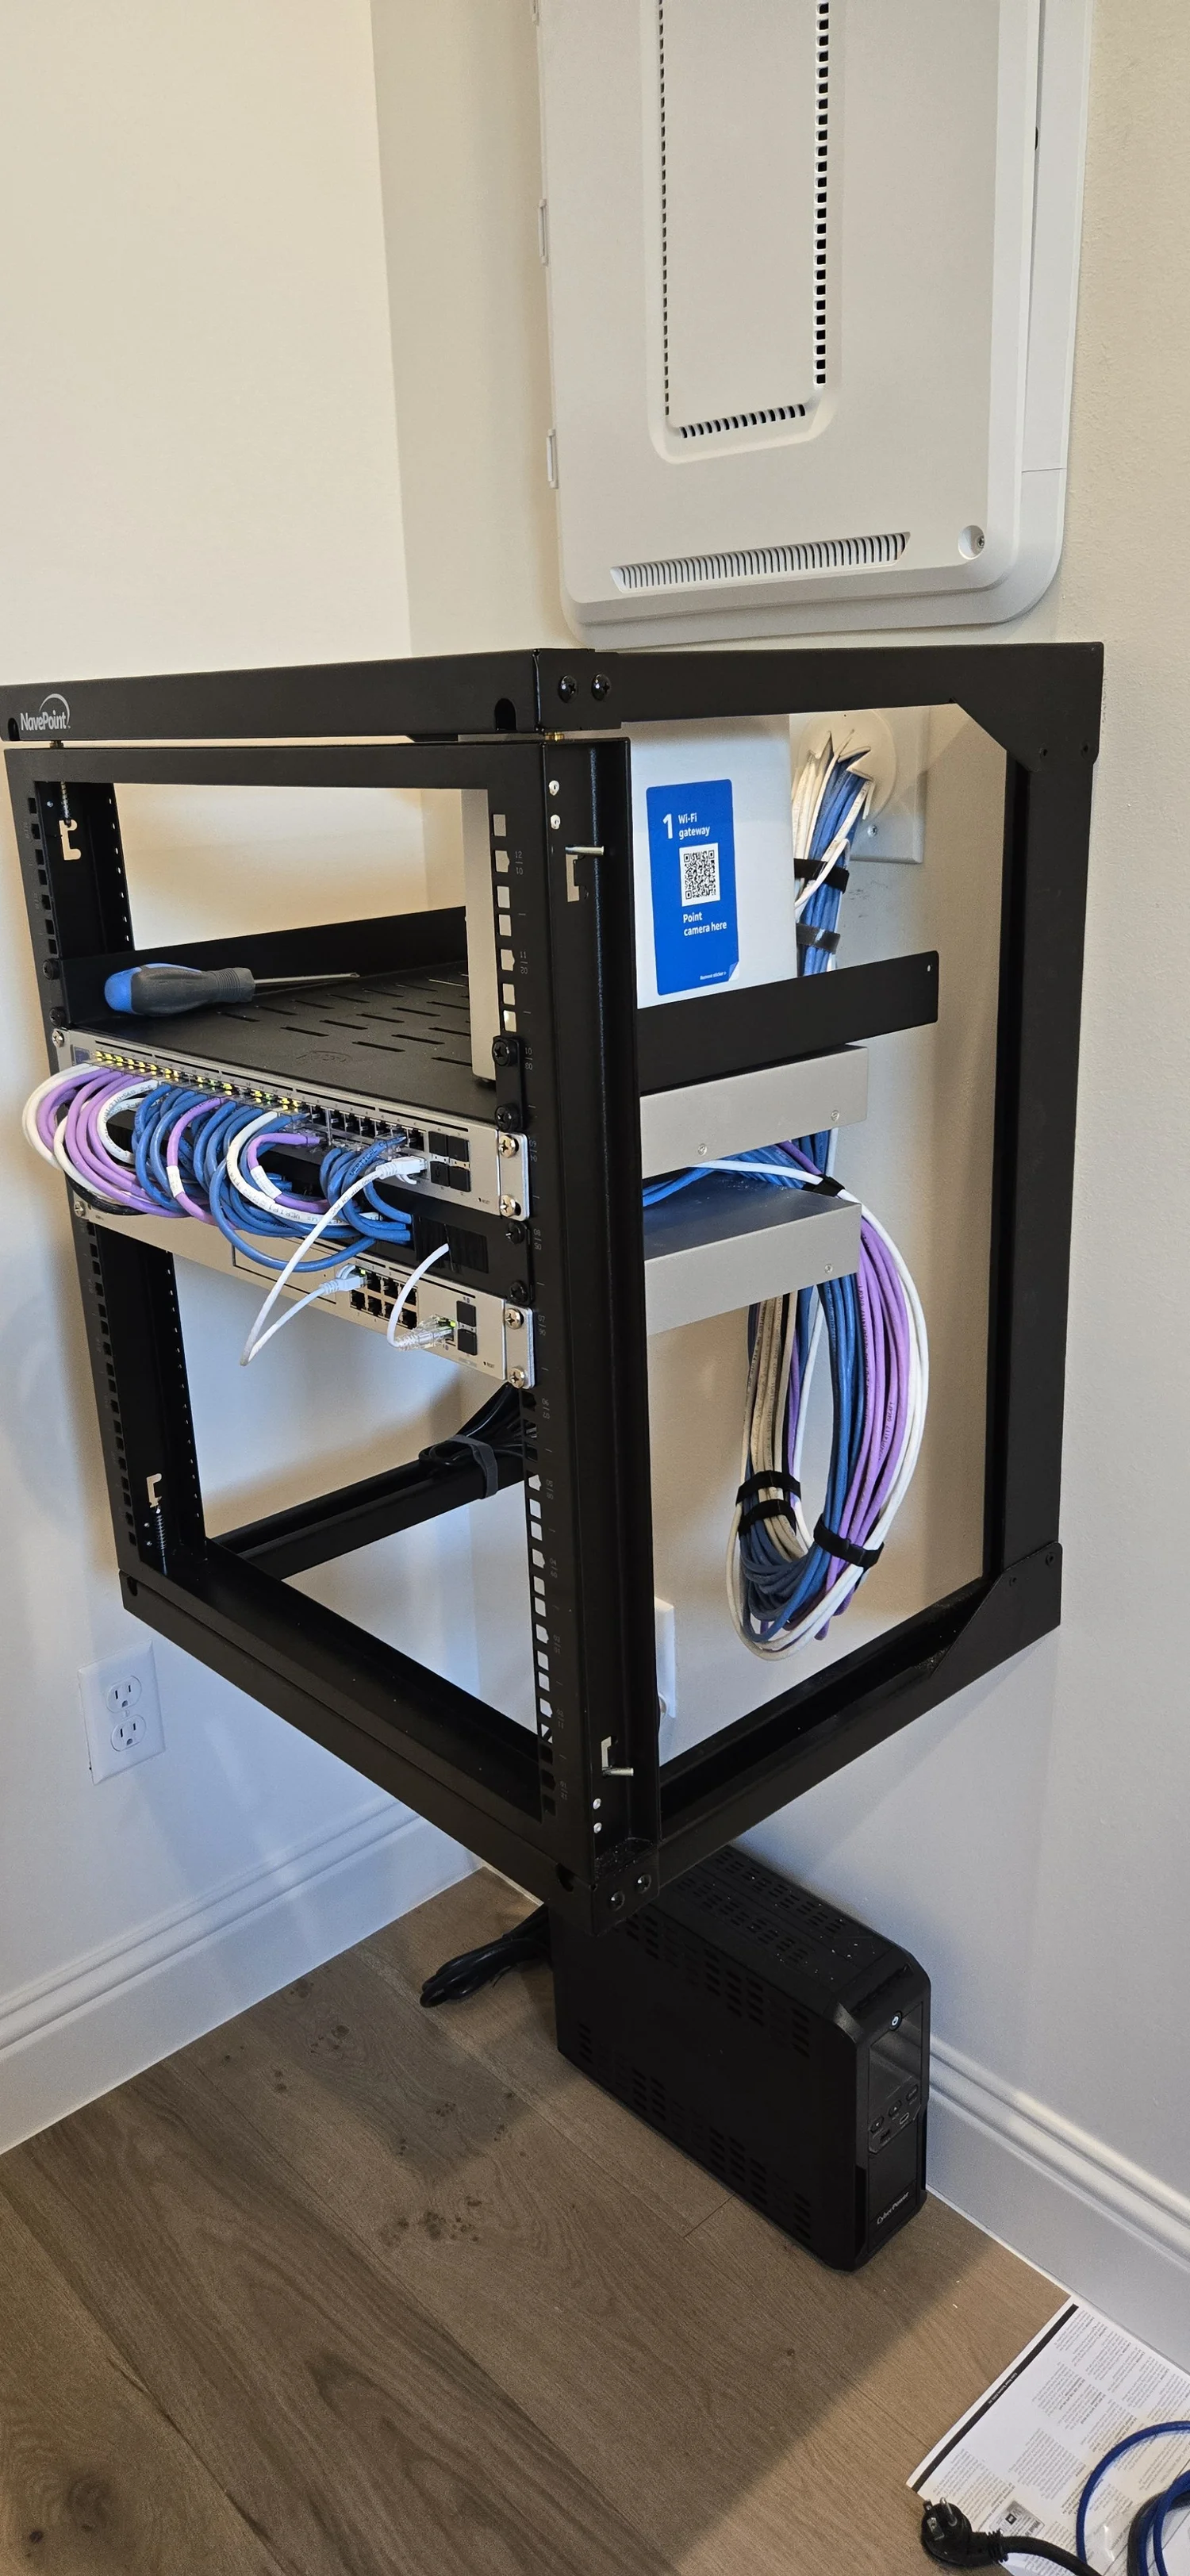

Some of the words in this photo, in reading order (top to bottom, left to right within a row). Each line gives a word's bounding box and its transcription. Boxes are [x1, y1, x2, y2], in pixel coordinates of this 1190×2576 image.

[20, 710, 67, 731] NavePoint
[678, 812, 697, 824] Wi-Fi
[662, 813, 673, 839] 1
[678, 825, 710, 840] gateway
[682, 912, 703, 923] Point
[684, 924, 711, 937] camera
[711, 921, 727, 932] here
